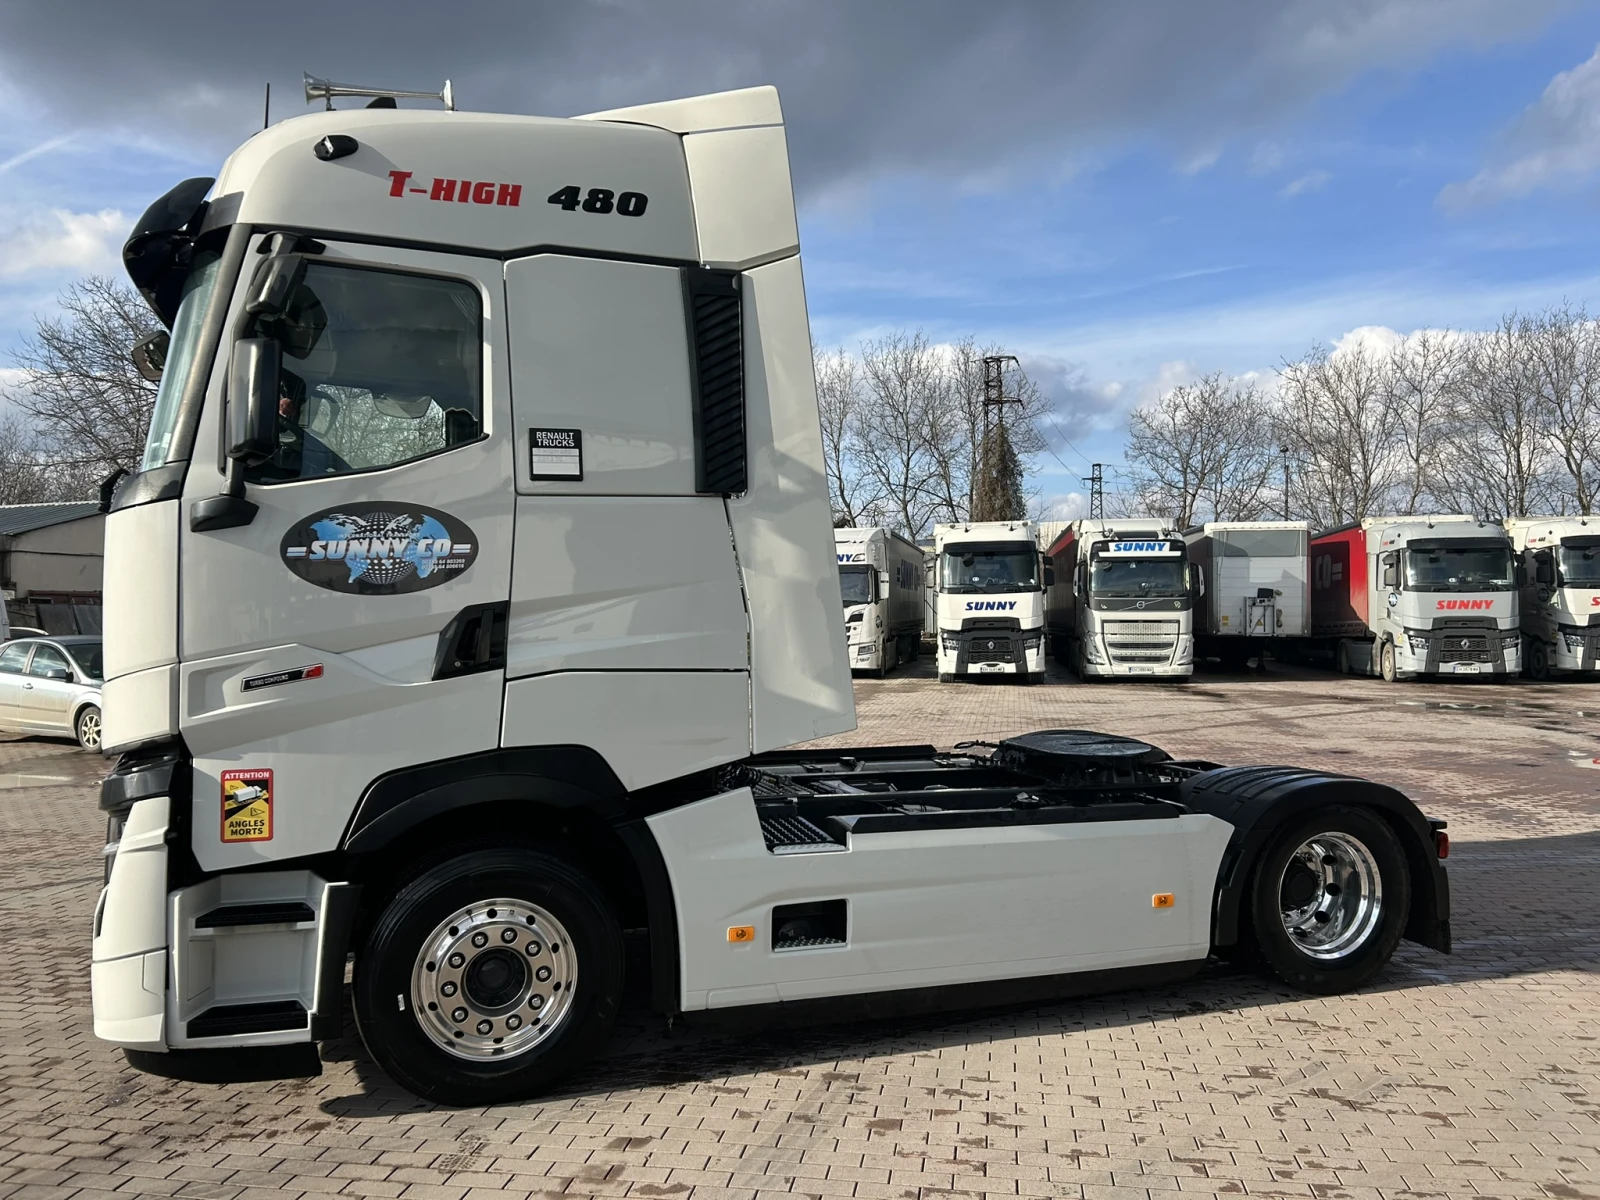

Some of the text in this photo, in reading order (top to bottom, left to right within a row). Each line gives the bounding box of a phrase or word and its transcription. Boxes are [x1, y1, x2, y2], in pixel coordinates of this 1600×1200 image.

[387, 170, 649, 218] T-HIGH 480
[536, 431, 575, 440] RENAULT
[536, 439, 575, 447] TRUCKS
[309, 537, 452, 560] SUNNY CO
[1113, 542, 1166, 552] SUNNY
[965, 601, 1017, 611] SUNNY
[1436, 599, 1495, 611] SUNNY
[224, 771, 270, 780] ATTENTION
[228, 819, 265, 828] ANGLES
[230, 827, 263, 836] MORTS
